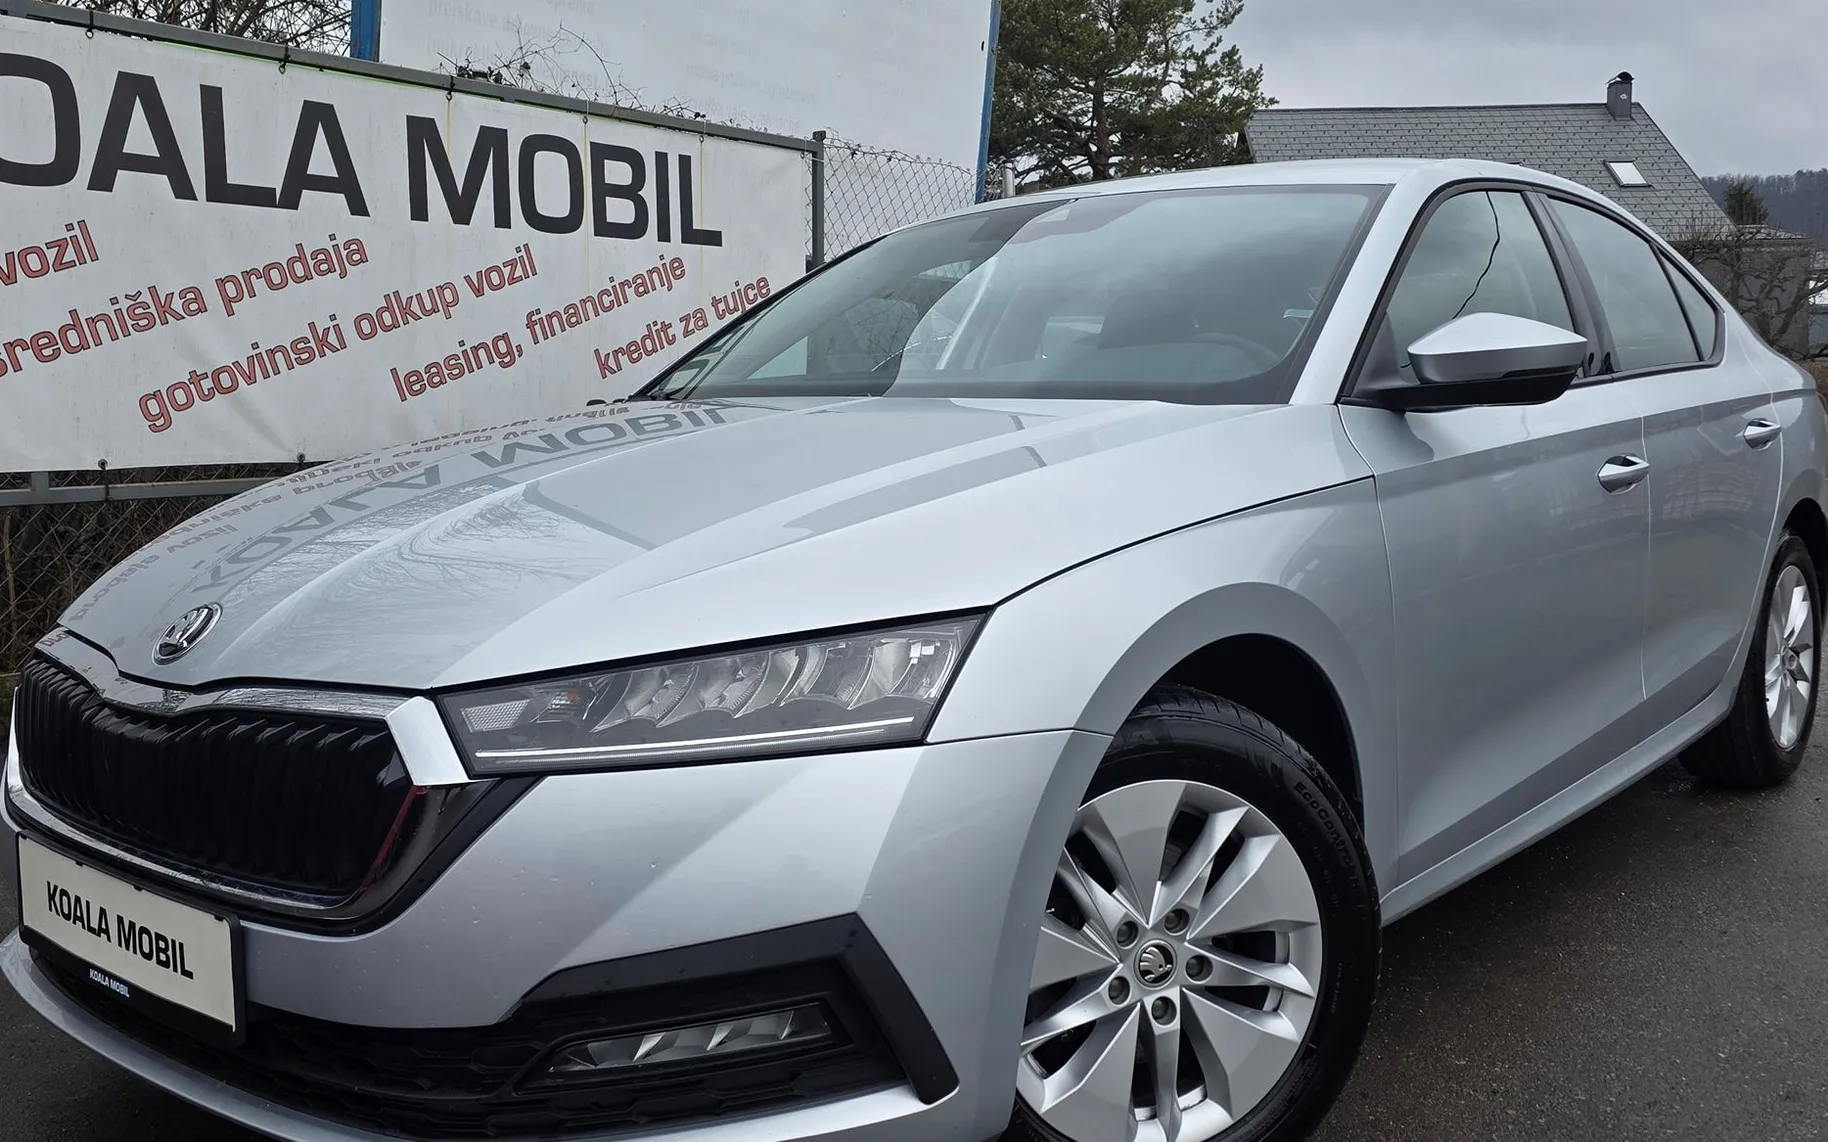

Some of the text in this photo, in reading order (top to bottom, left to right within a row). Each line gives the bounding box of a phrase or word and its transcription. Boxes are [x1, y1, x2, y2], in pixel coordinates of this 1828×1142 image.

[407, 115, 722, 246] MOBIL
[0, 220, 99, 286] vozil
[215, 236, 368, 317] prodaja
[139, 244, 537, 433] gotovinski odkup vozil
[390, 258, 685, 402] leasing, financiranje
[594, 277, 776, 379] kredit za tujce
[47, 880, 194, 980] KOALA MOBIL
[90, 968, 130, 997] KOALA MOBIL
